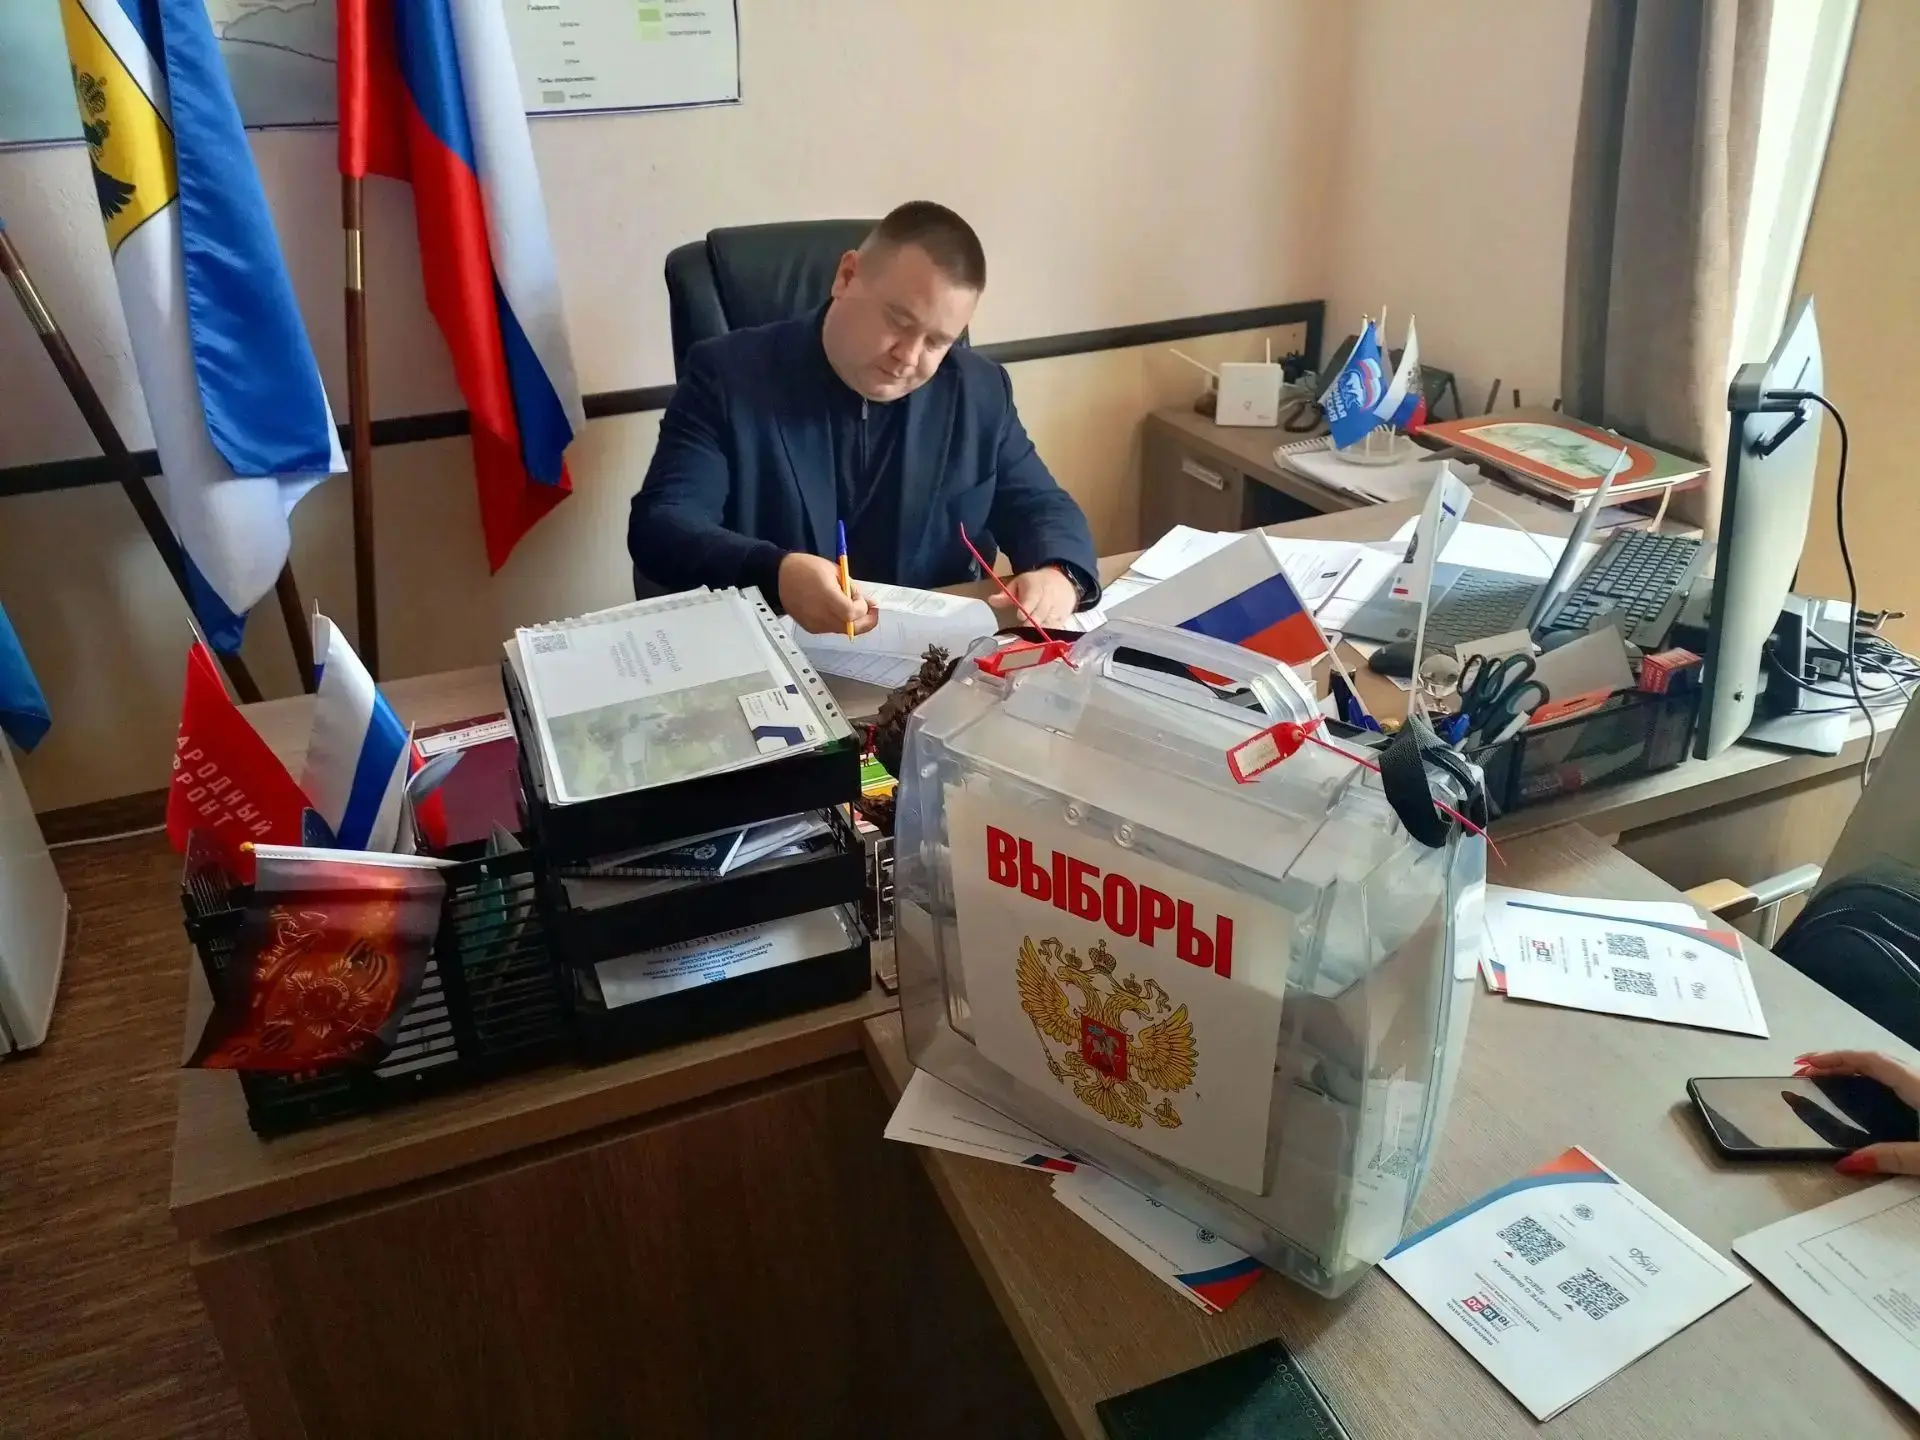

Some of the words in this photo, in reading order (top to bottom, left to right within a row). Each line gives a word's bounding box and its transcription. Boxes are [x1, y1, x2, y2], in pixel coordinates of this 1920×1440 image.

[177, 735, 273, 836] АРОДНЫЙ
[986, 824, 1234, 979] ВЫБОРЫ
[1465, 1297, 1482, 1311] 20
[1482, 1307, 1497, 1319] 19
[1496, 1315, 1511, 1327] 18
